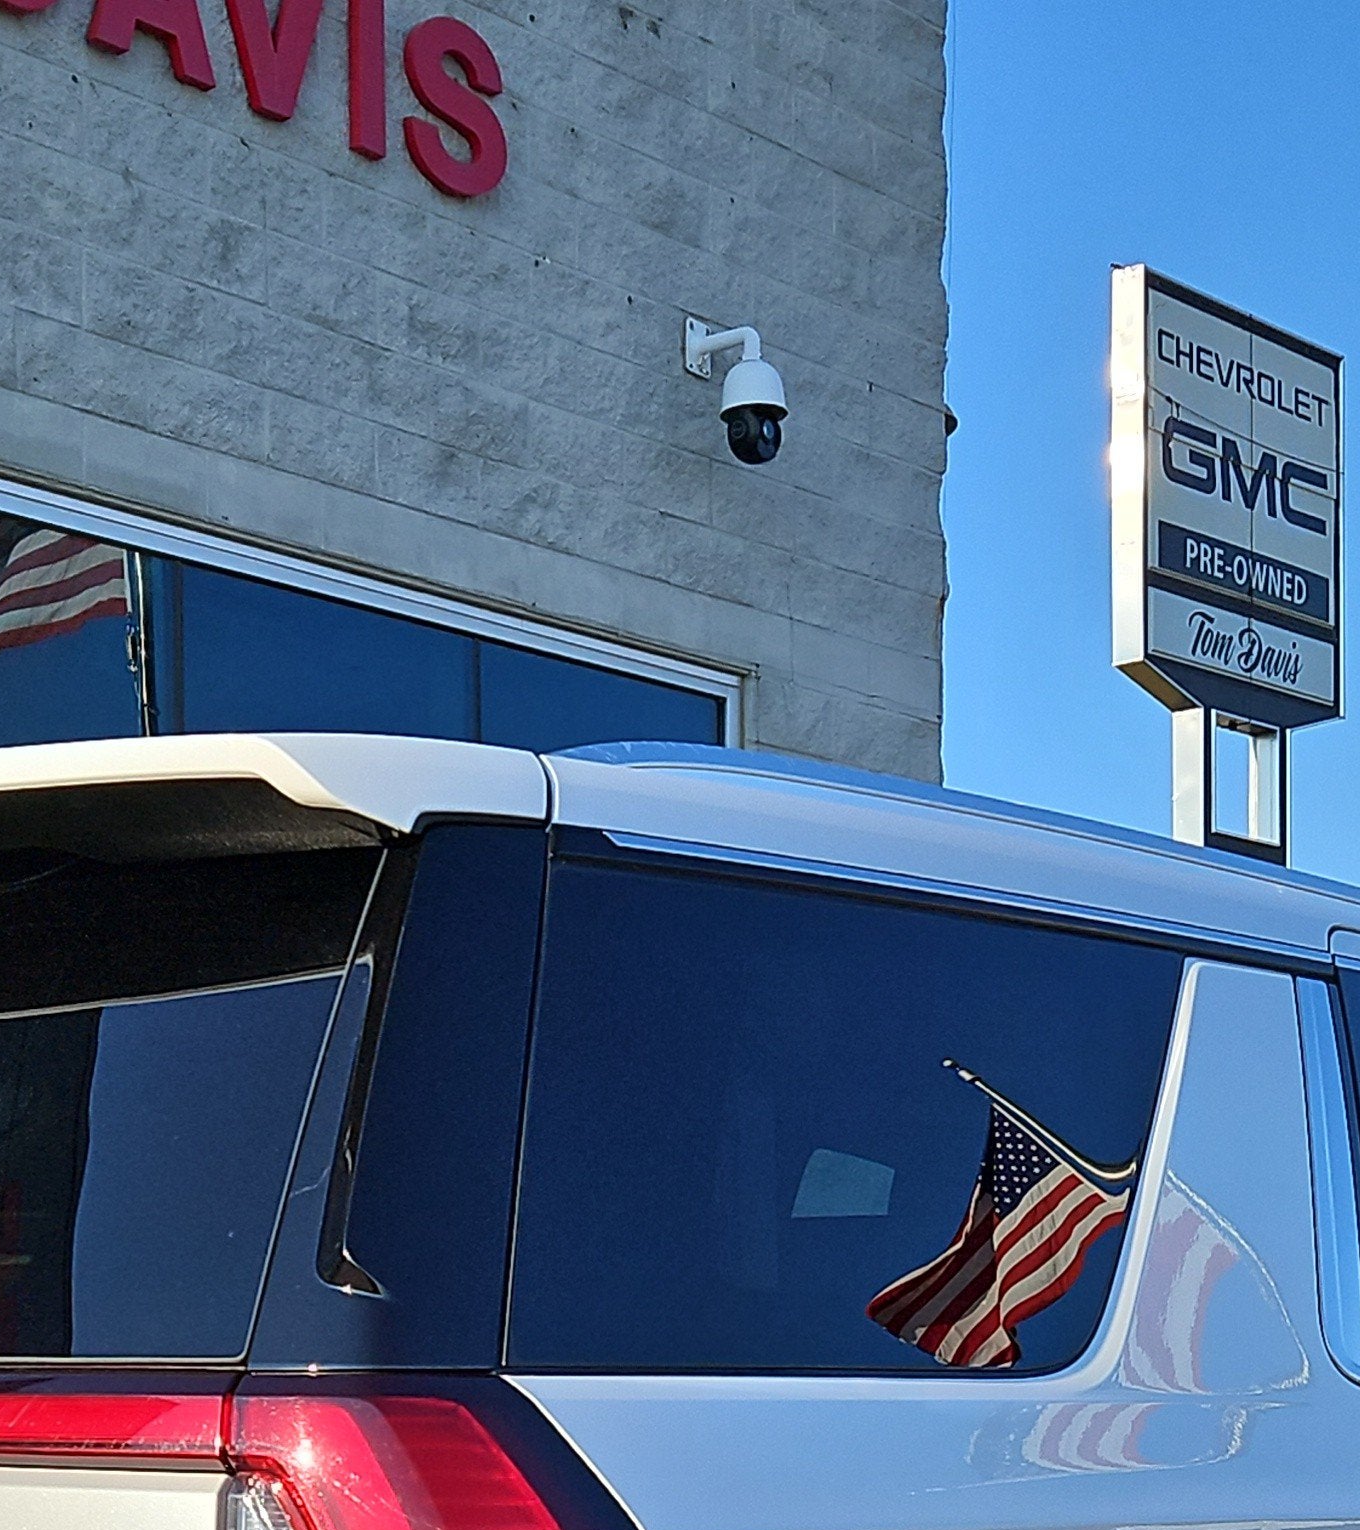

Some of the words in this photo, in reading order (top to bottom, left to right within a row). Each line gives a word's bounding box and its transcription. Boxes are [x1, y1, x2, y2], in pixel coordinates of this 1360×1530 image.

[1157, 328, 1331, 428] CHEVROLET
[1161, 415, 1329, 536] GMC
[1185, 536, 1307, 606] PRE-OWNED
[1188, 611, 1236, 666] Tom
[1237, 627, 1304, 685] Davis
